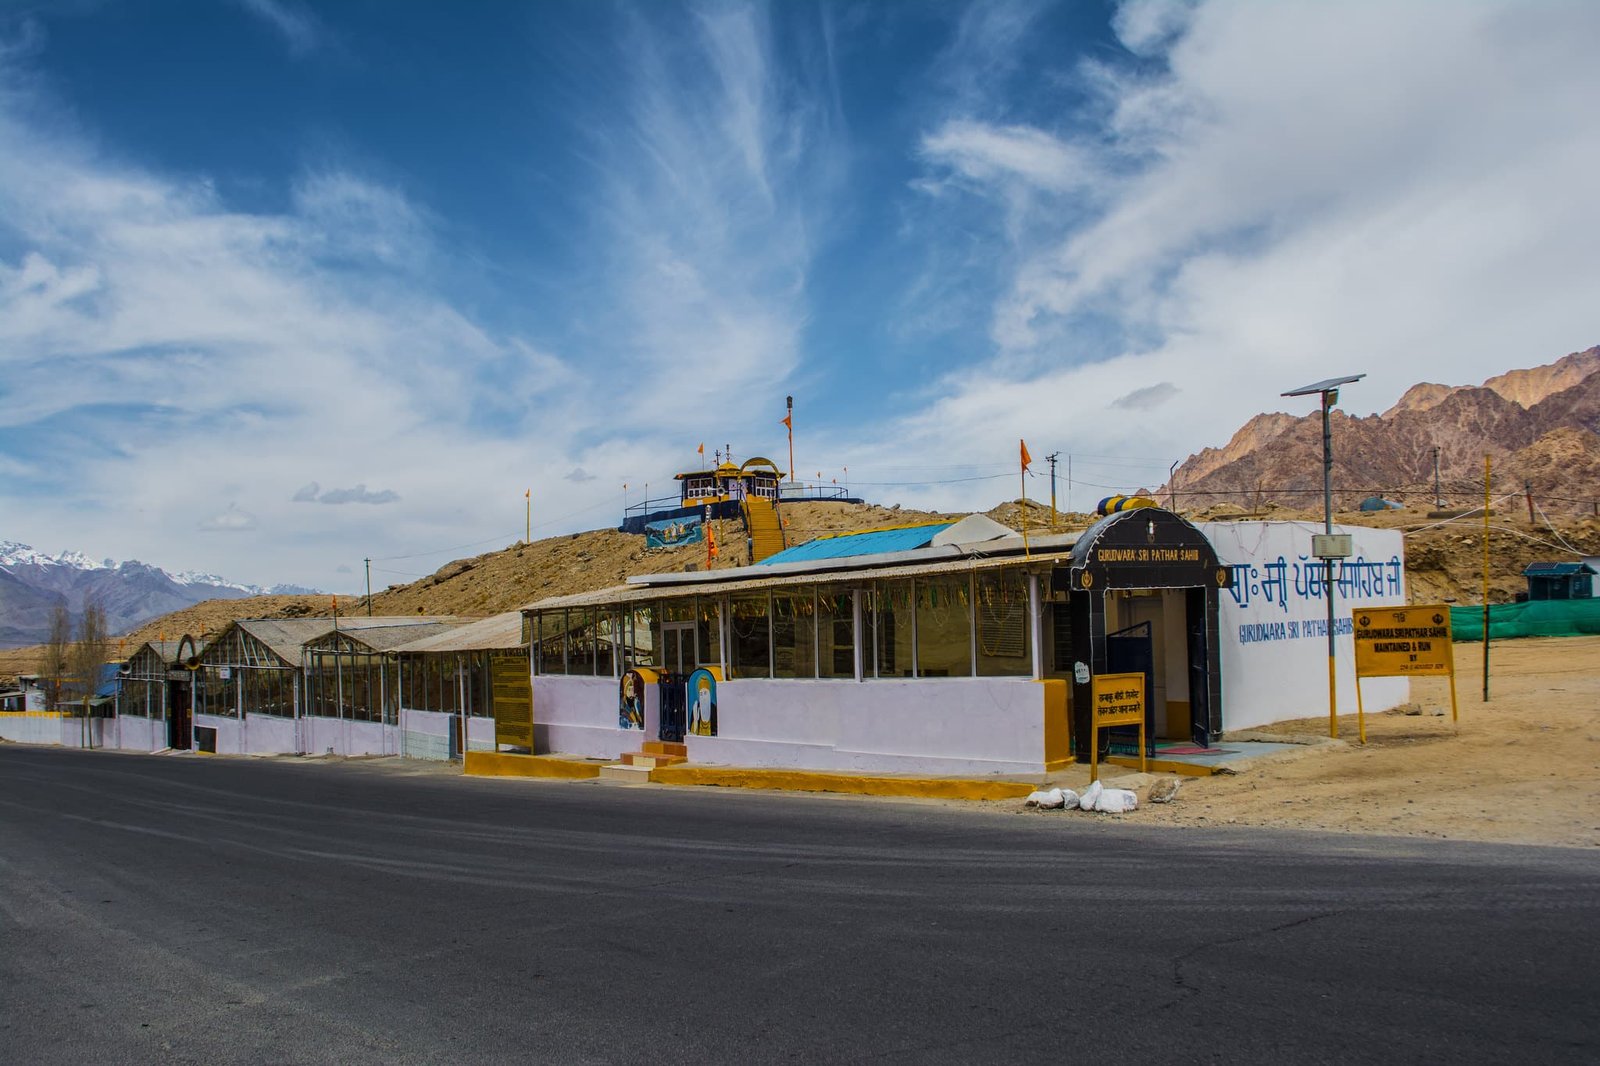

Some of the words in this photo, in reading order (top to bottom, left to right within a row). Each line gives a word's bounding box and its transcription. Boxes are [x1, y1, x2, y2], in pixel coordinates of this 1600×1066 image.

[1138, 549, 1149, 561] SRI
[1151, 549, 1178, 561] PATHAR
[1181, 549, 1199, 561] SAHIB
[1386, 555, 1401, 597] ਜੀ
[1287, 621, 1299, 639] SRI
[1302, 619, 1329, 638] PATHA
[1374, 642, 1411, 653] MAINTAINED
[1418, 641, 1432, 652] RUN
